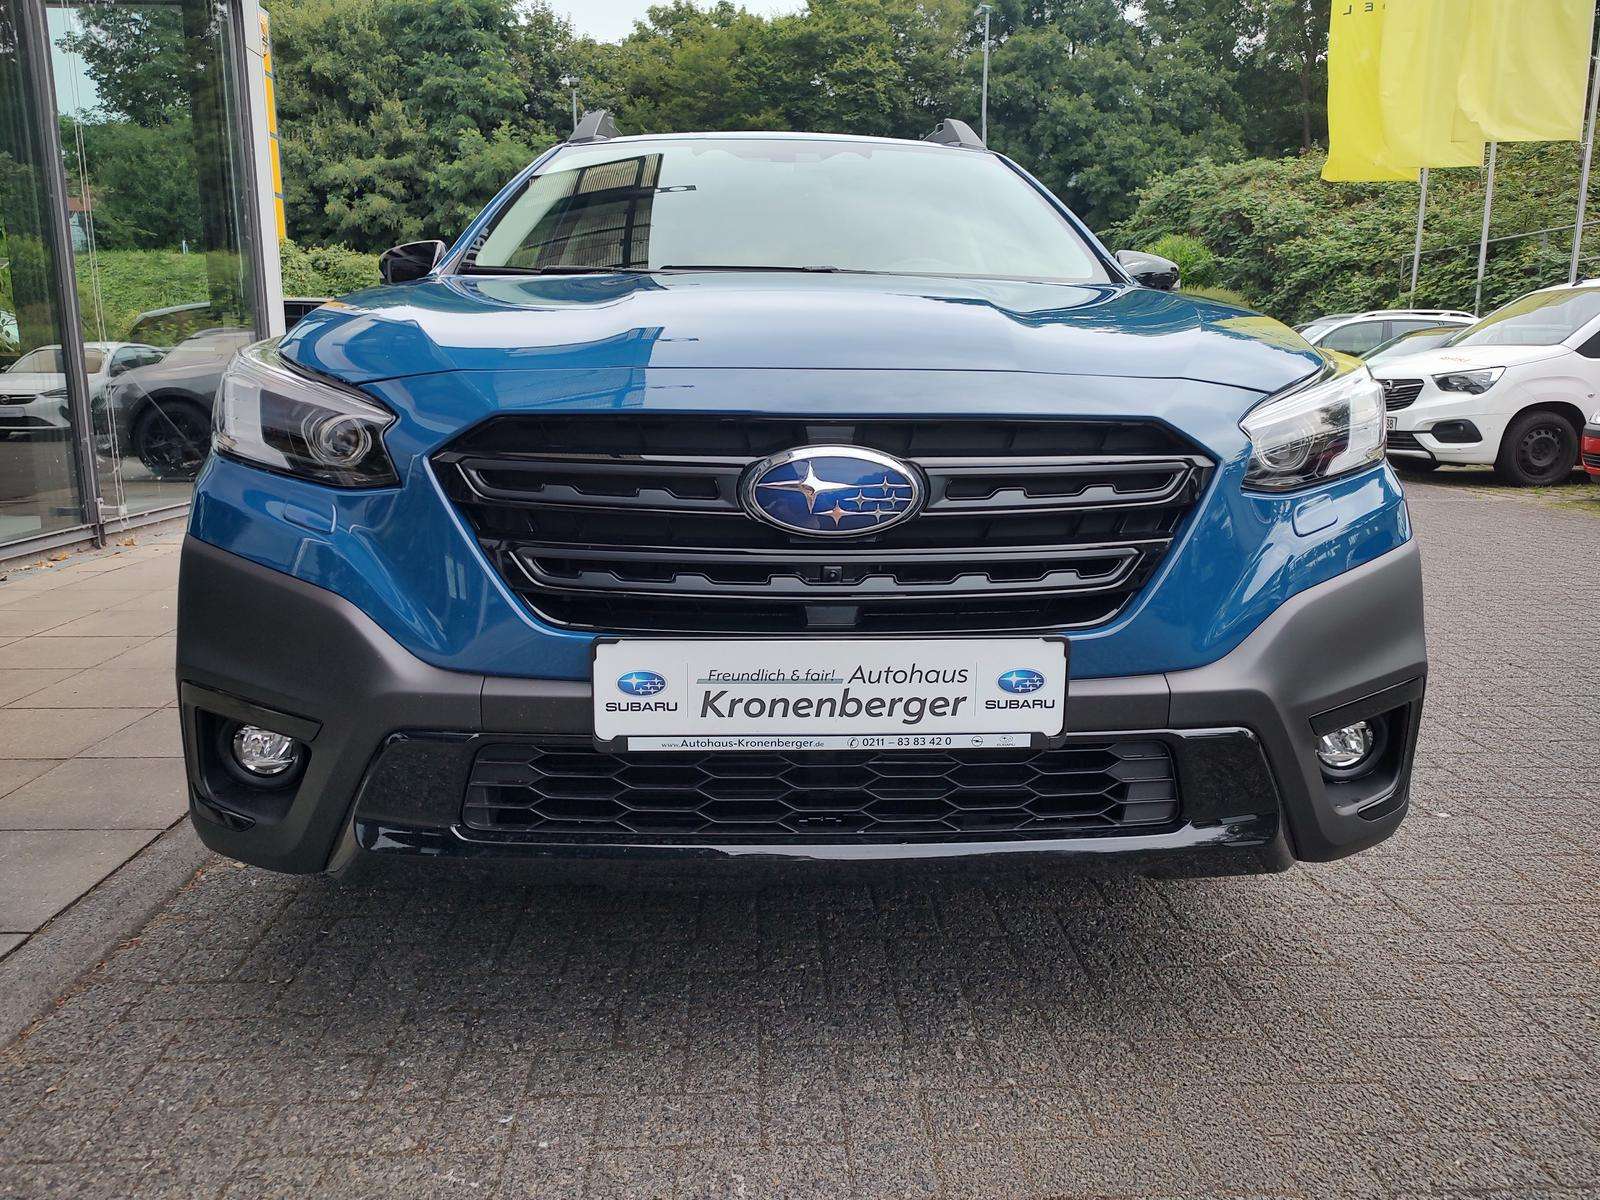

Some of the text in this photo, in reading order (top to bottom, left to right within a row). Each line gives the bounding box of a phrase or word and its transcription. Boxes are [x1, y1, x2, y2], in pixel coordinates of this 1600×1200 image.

[708, 669, 836, 682] Freundlich & fair!
[847, 663, 969, 684] Autohaus
[605, 702, 678, 712] SUBARU
[700, 687, 968, 725] Kronenberger
[984, 699, 1055, 709] SUBARU
[661, 739, 824, 748] www.Autohaus-Kronenberger.de
[862, 738, 885, 746] 0211
[897, 737, 910, 746] 83
[913, 737, 926, 746] 83
[928, 737, 942, 746] 42
[944, 736, 952, 746] 0
